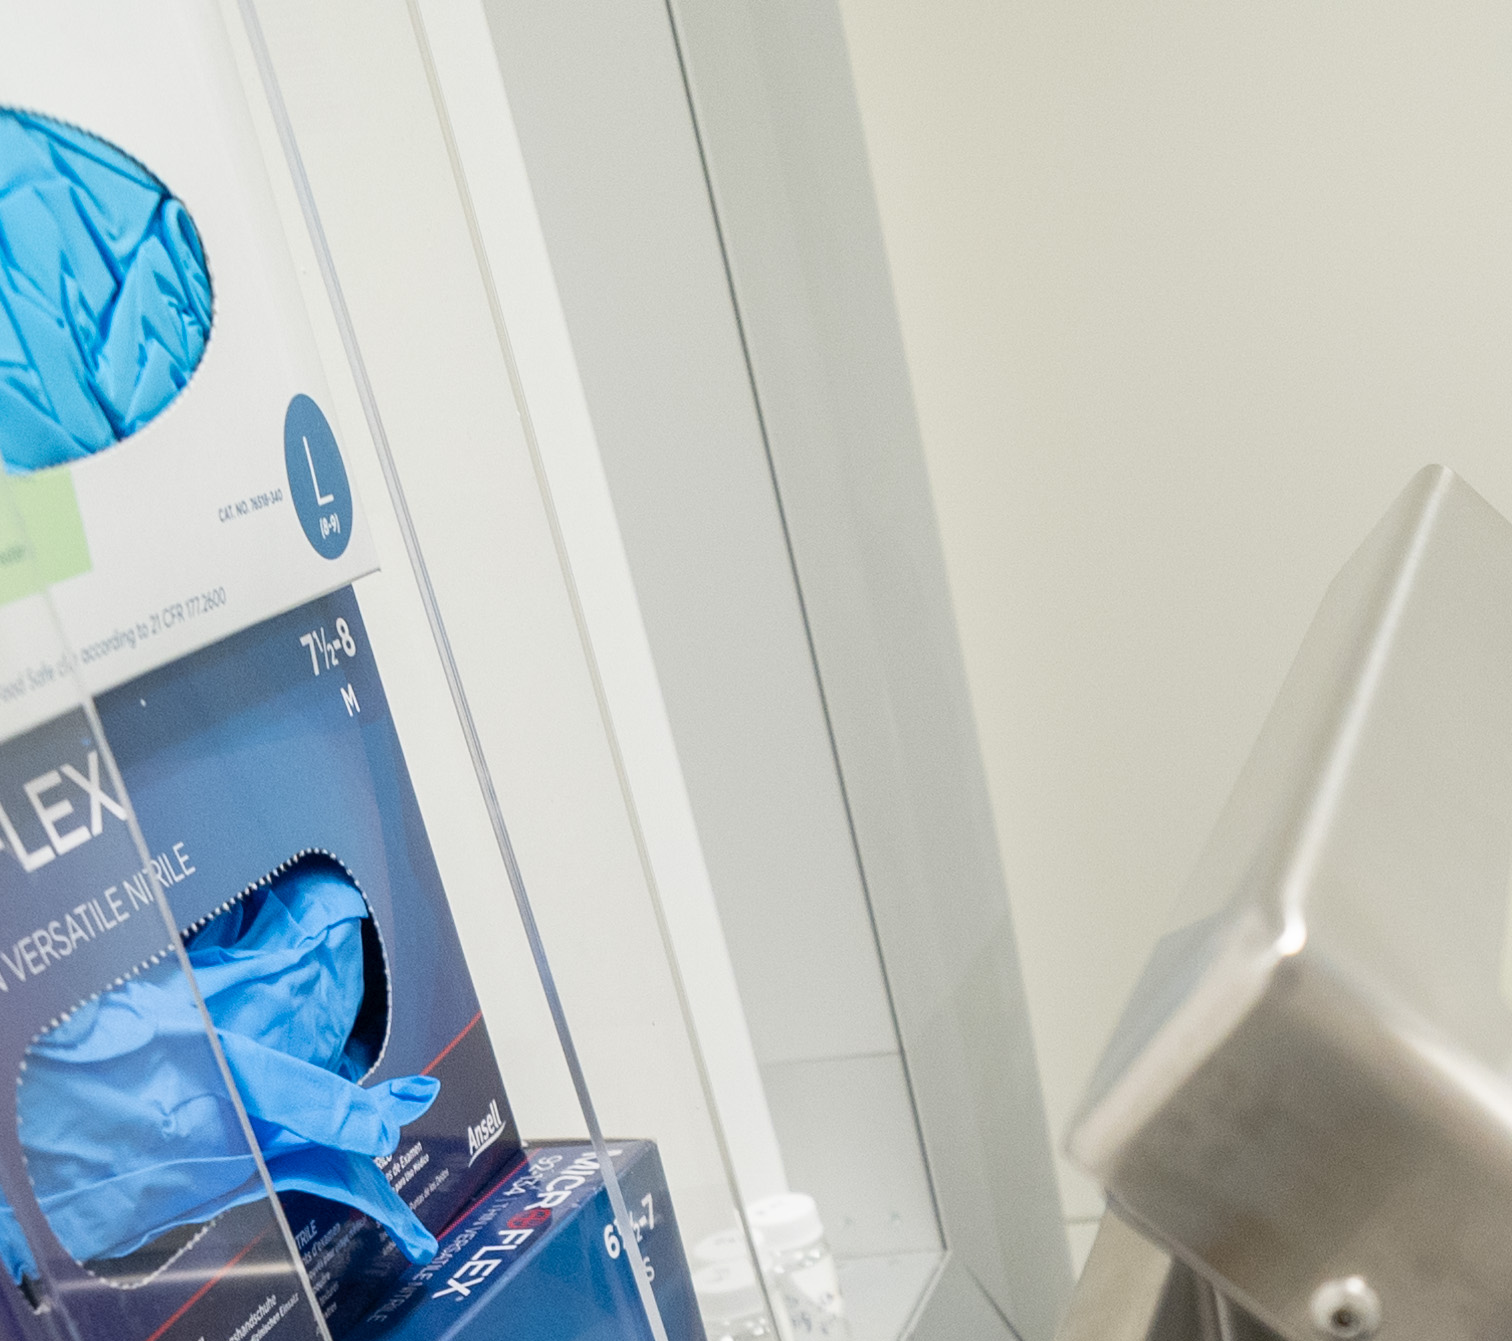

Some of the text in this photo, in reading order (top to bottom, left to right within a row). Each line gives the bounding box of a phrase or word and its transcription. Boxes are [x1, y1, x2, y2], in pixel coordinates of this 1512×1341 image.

[302, 436, 334, 506] L
[218, 505, 236, 523] CAT.
[319, 513, 341, 539] (8-9)
[80, 621, 136, 665] according
[161, 602, 186, 632] CFR
[340, 685, 361, 717] M
[467, 1098, 503, 1157] Ansell
[295, 1219, 319, 1250] TRILE
